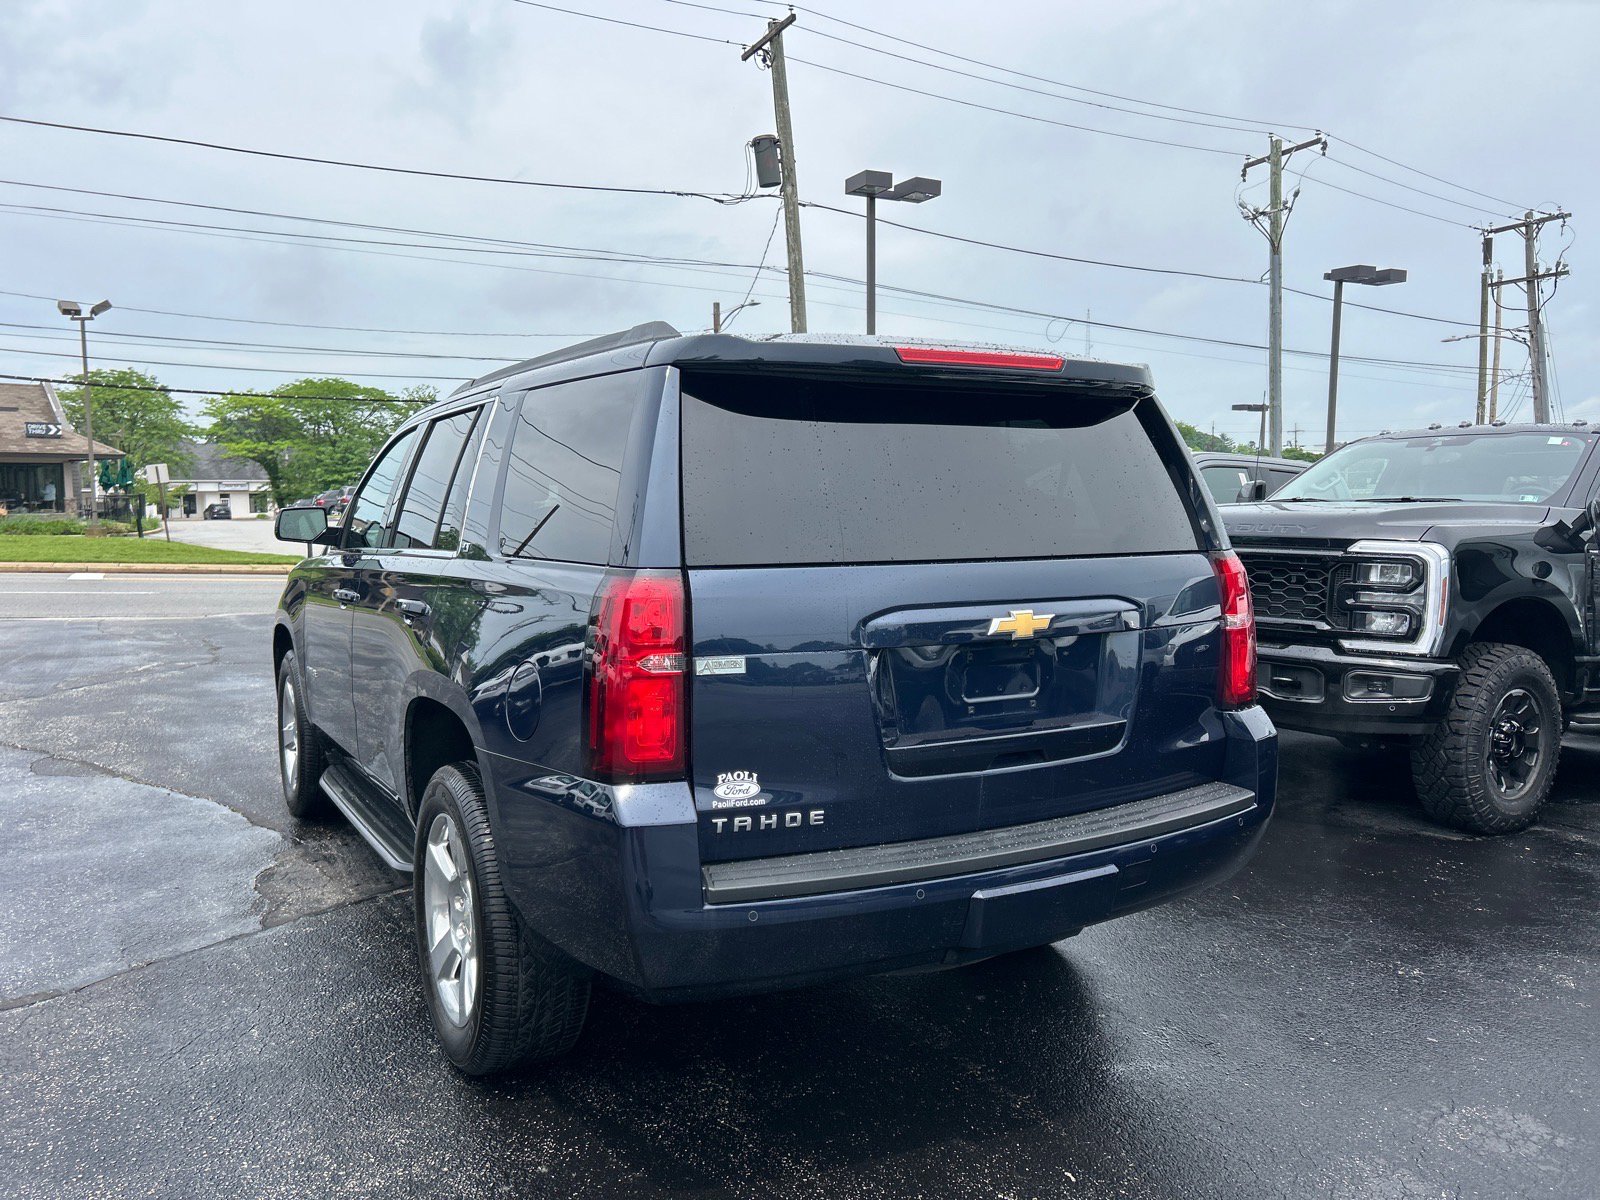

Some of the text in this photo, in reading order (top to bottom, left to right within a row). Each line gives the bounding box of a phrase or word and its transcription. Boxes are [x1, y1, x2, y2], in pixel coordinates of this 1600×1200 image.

[1234, 522, 1320, 534] DUTY
[717, 770, 758, 784] PAOLI
[723, 783, 752, 796] Ford
[712, 797, 766, 809] PaoliFord.com
[711, 810, 825, 834] TAHOE
